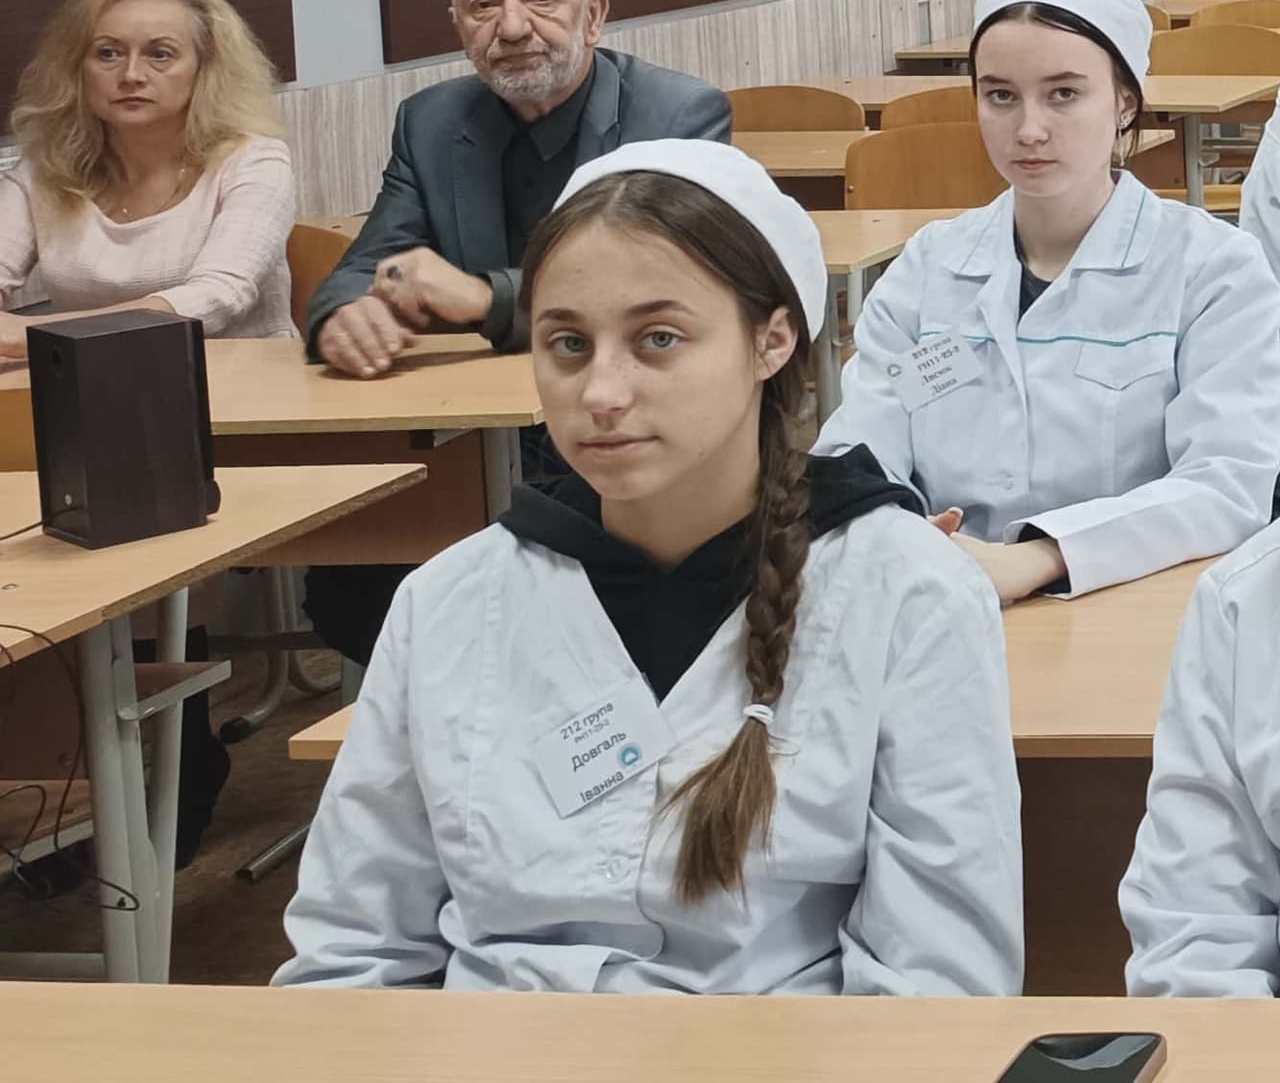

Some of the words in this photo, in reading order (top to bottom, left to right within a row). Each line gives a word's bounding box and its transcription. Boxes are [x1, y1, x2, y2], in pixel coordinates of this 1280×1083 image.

[560, 720, 582, 740] 212
[582, 702, 614, 727] група
[571, 732, 627, 773] Довгаль
[580, 771, 625, 802] Іванна
